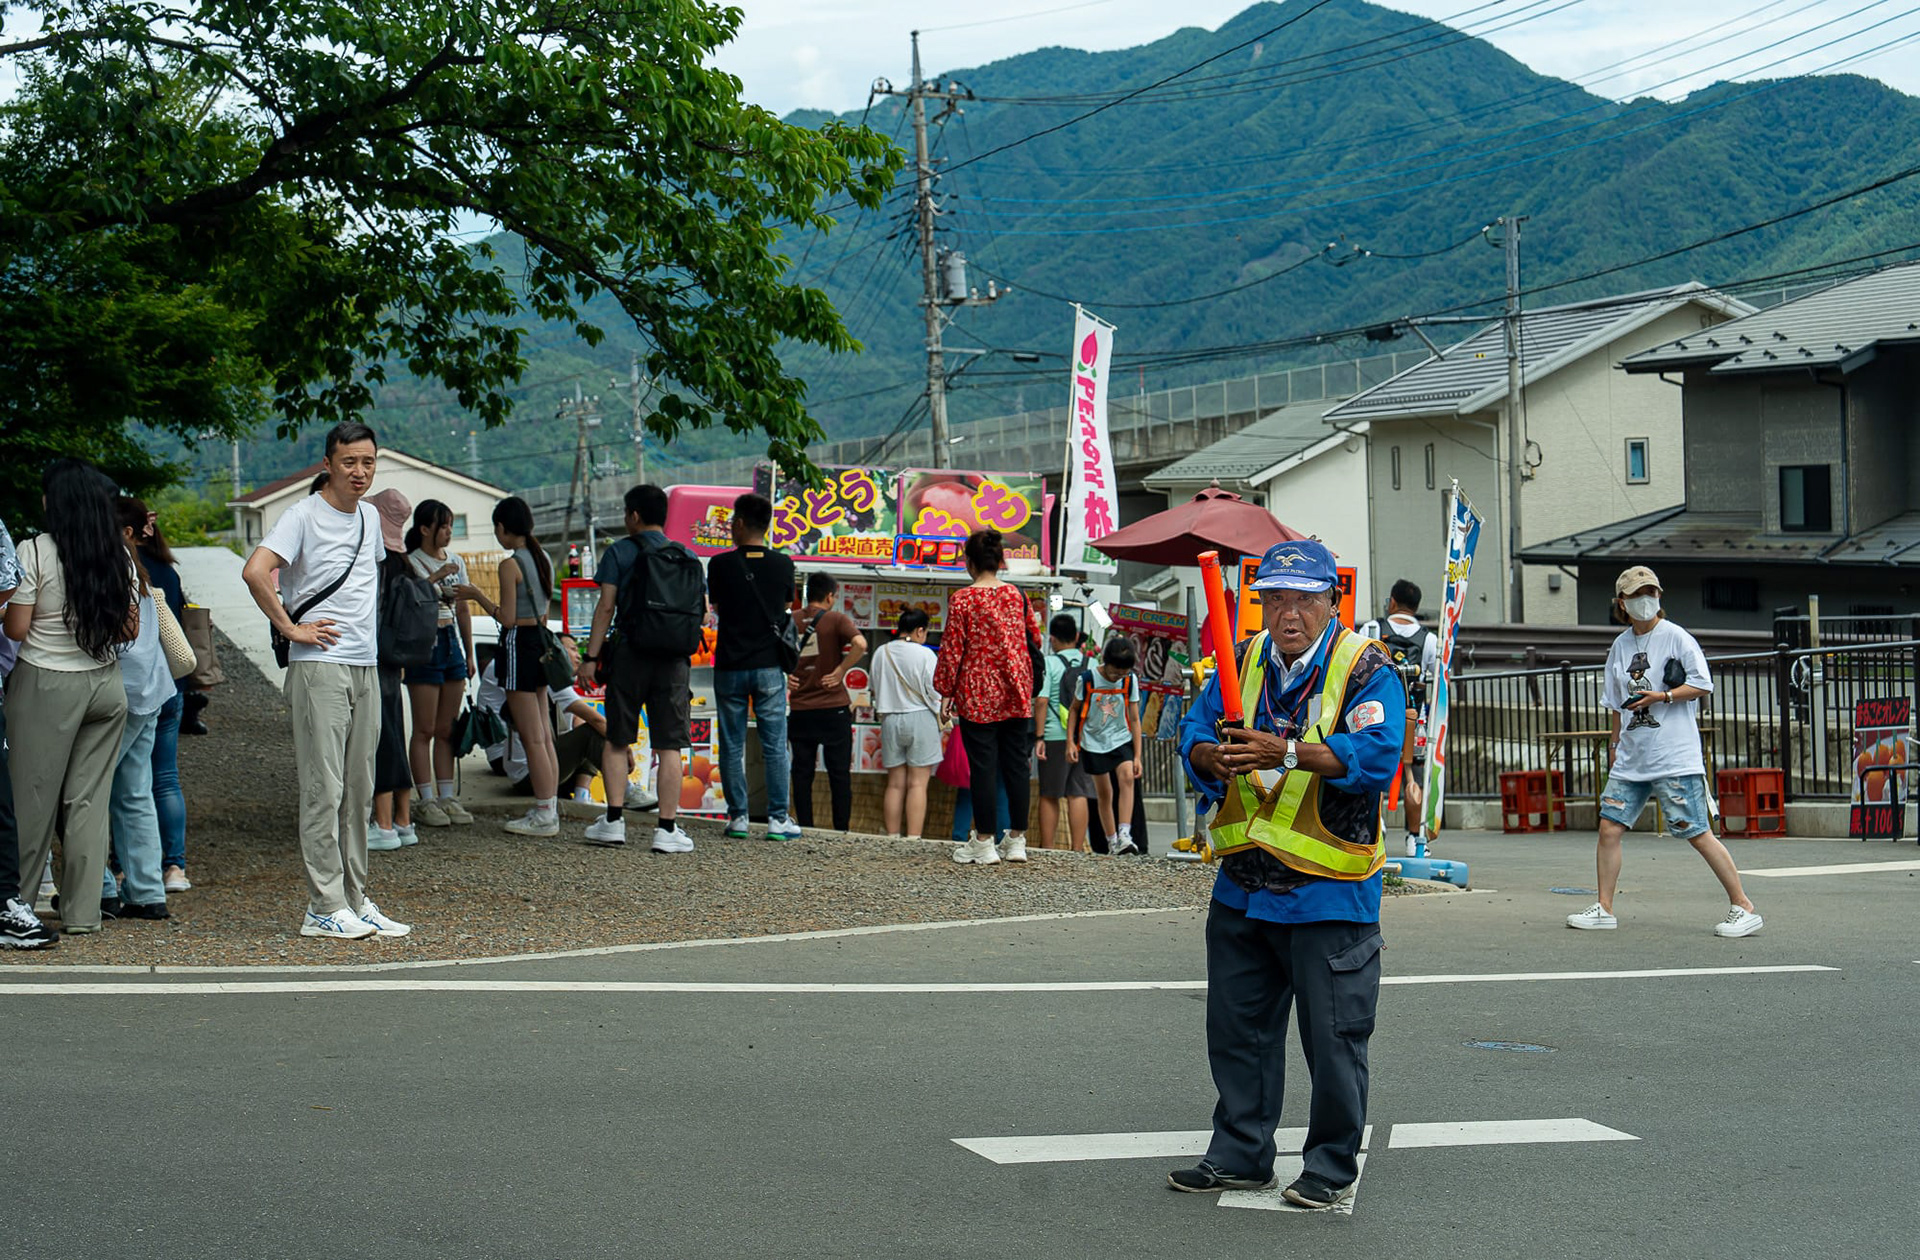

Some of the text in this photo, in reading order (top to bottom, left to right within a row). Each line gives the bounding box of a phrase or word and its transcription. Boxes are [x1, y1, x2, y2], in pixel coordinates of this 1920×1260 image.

[766, 469, 877, 547] ぶどう
[819, 535, 894, 557] 山梨直売
[1120, 607, 1186, 628] ICE CREAM
[1856, 699, 1909, 728] まるごとオレンジ
